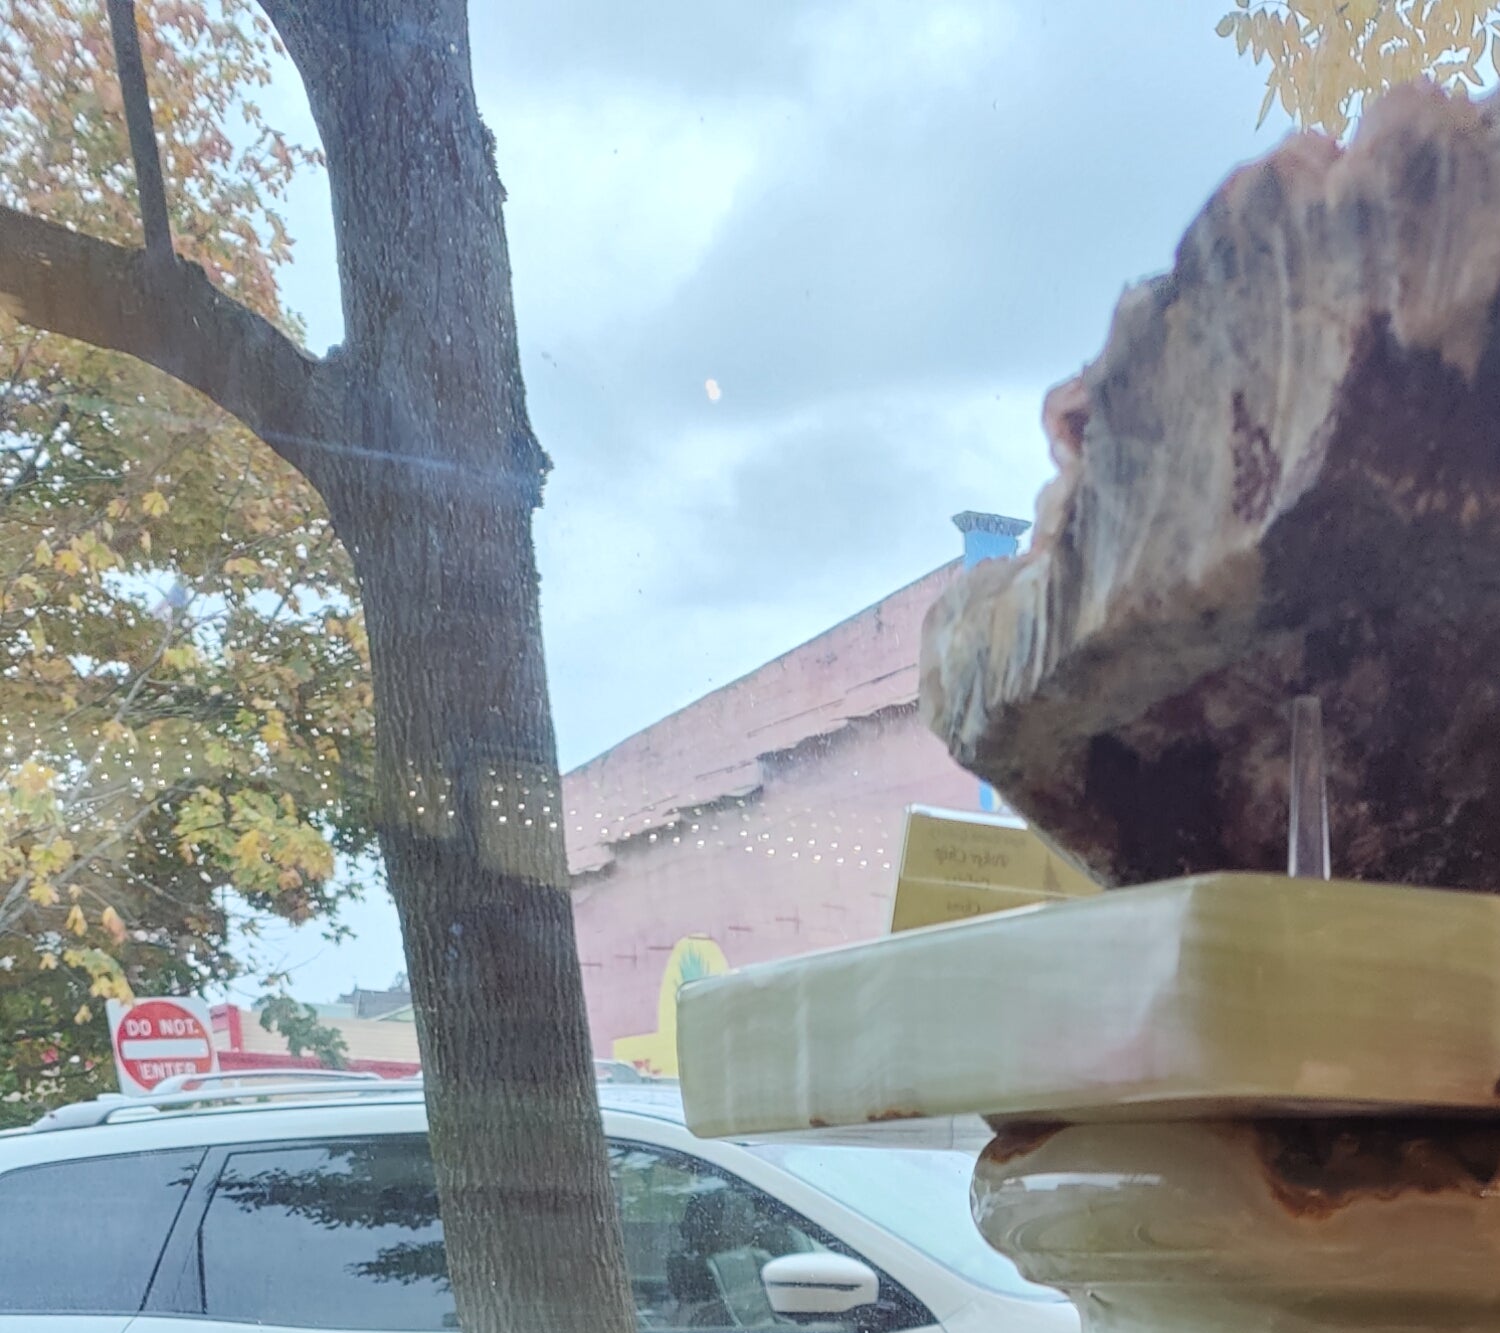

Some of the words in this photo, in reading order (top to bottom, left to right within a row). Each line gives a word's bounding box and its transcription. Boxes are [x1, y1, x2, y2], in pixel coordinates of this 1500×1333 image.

[126, 1019, 151, 1036] DO
[159, 1019, 195, 1035] NOT
[141, 1062, 197, 1080] ENTER
